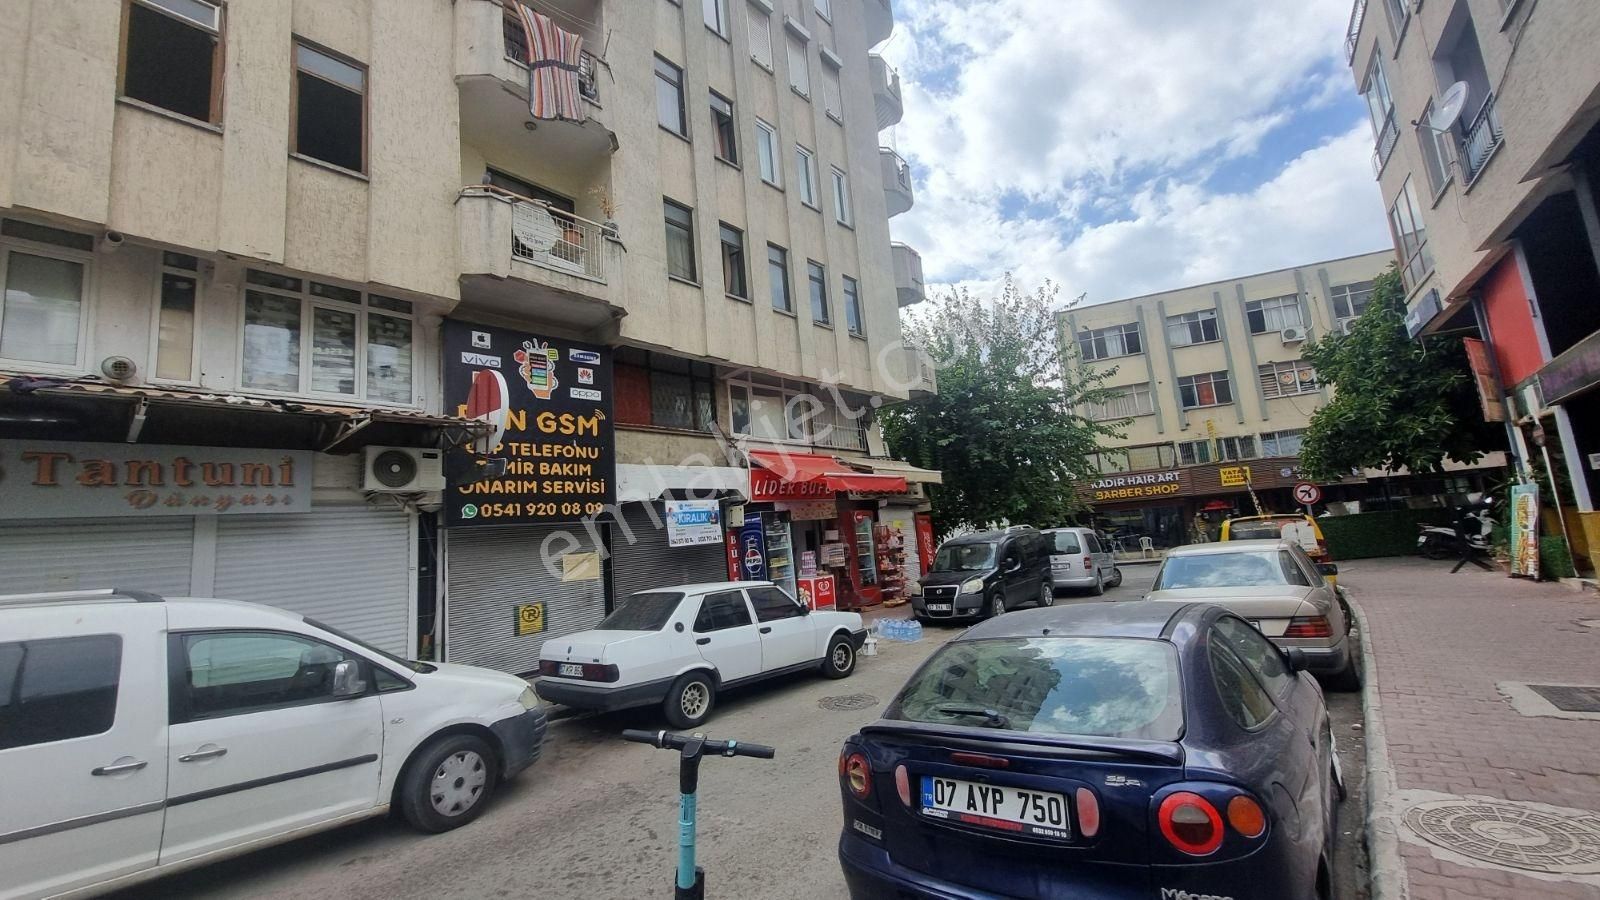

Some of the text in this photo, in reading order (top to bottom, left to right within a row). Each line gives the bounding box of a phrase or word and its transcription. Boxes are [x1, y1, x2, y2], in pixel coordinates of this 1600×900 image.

[463, 355, 500, 367] vivo
[536, 411, 598, 437] GSM
[465, 442, 599, 459] CP TELEFONU
[21, 451, 296, 487] Tantuni
[539, 463, 592, 476] BAKIM
[542, 478, 605, 494] SERVİSİ
[1091, 472, 1180, 489] KADIR HAIR ART
[1095, 484, 1180, 500] BARBER SHOP
[480, 502, 604, 517] 0541 920 08 09
[678, 512, 708, 524] KIRALIK
[925, 793, 933, 802] TR
[934, 779, 957, 807] 07
[966, 784, 1004, 815] AYP
[1017, 791, 1062, 826] 750
